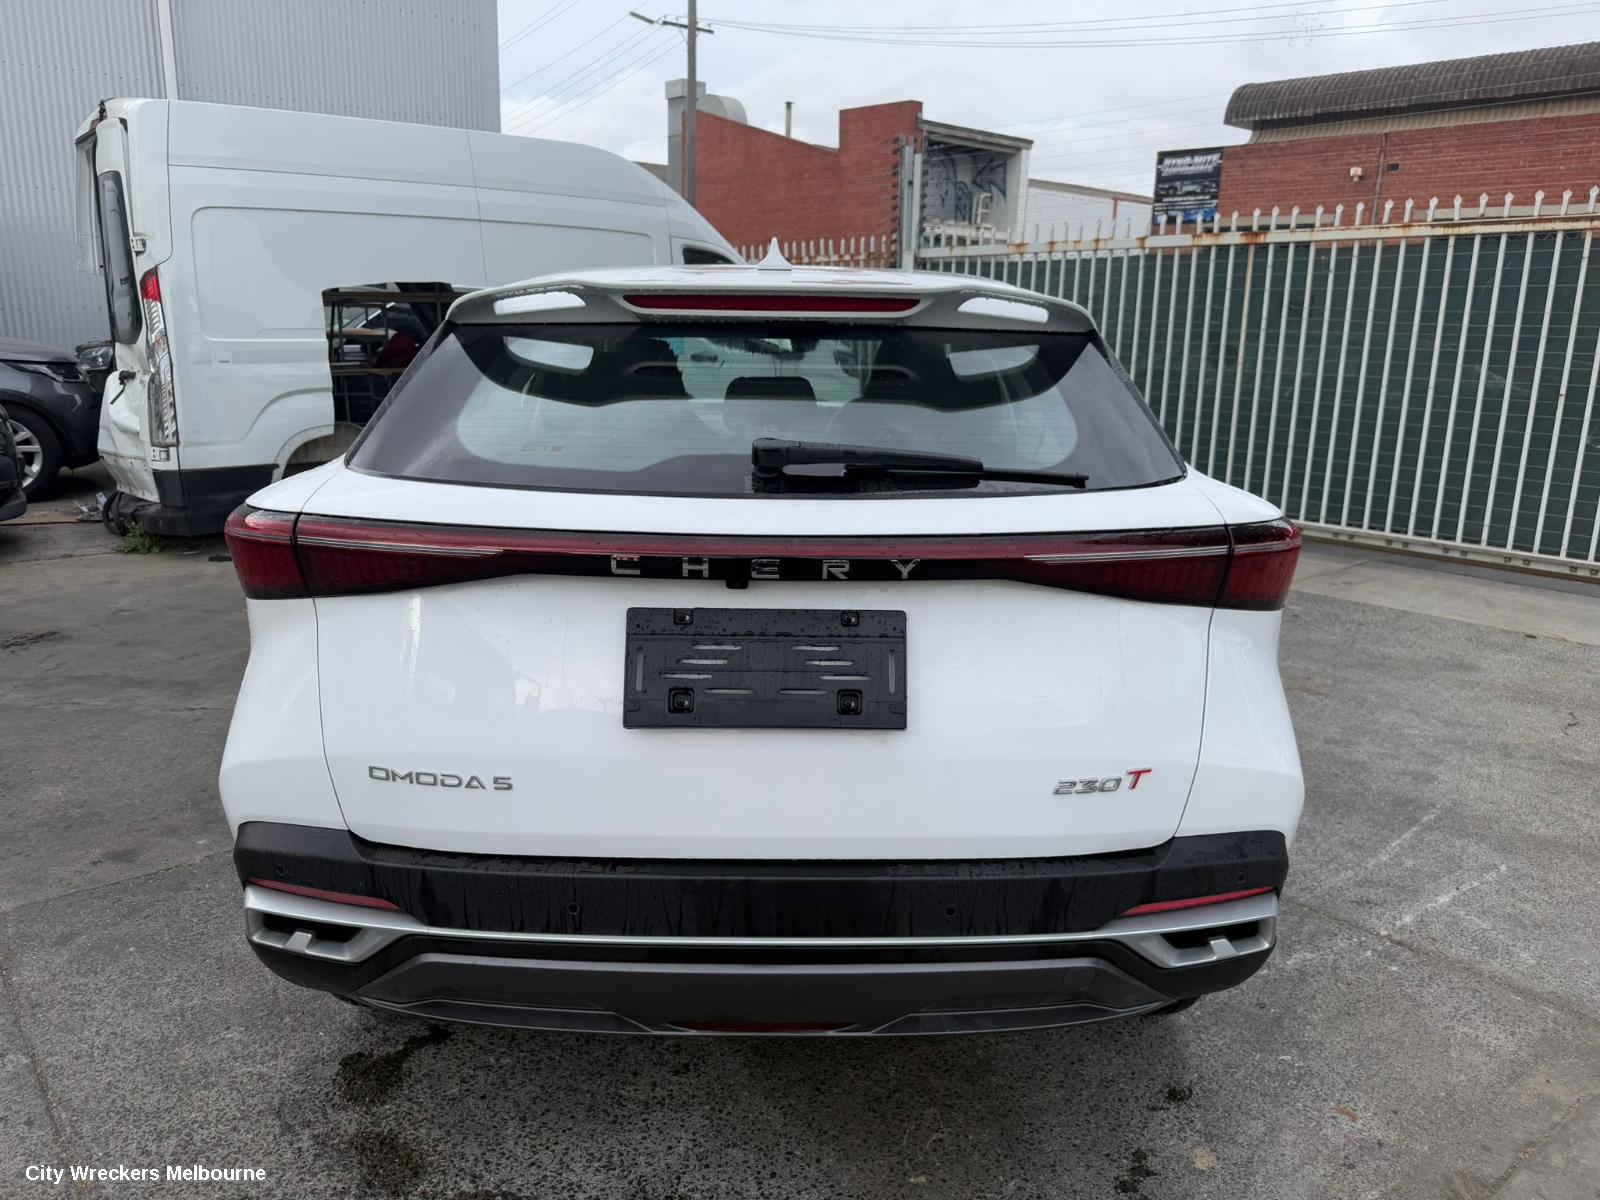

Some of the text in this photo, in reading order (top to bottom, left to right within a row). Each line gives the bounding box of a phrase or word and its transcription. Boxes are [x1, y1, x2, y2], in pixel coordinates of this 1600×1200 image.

[610, 554, 921, 580] CHERY
[368, 765, 513, 791] OMODA 5
